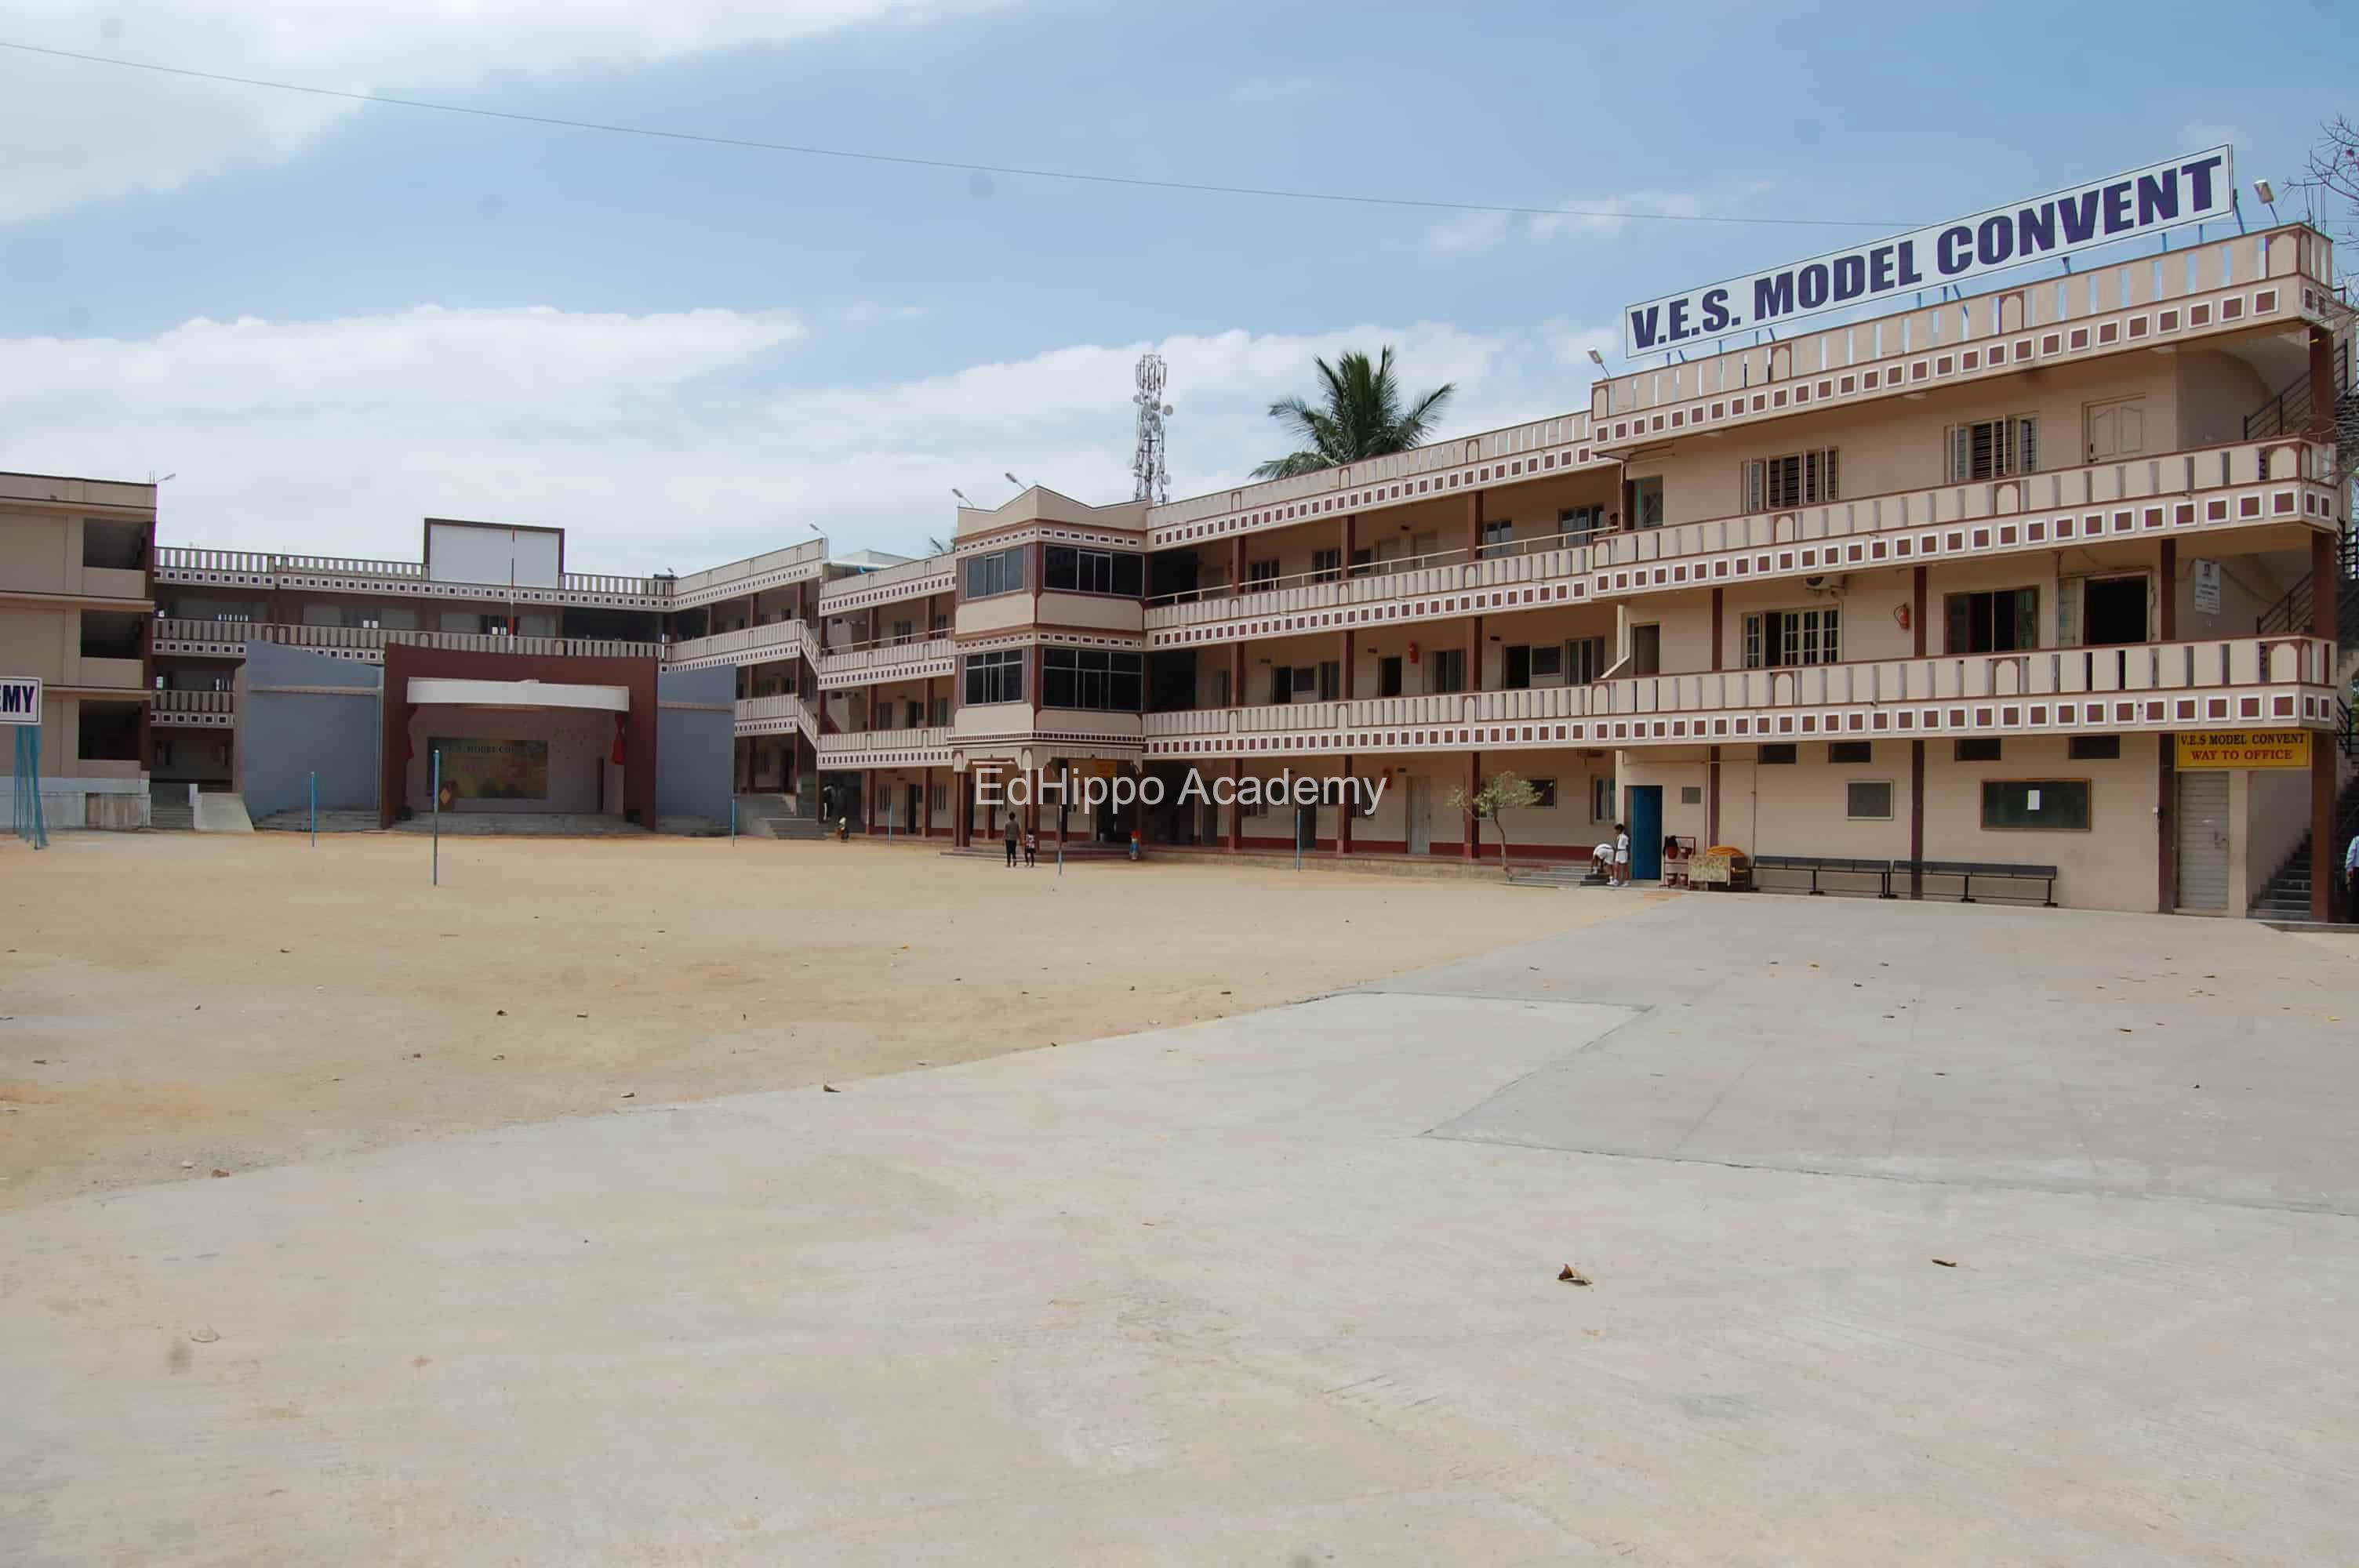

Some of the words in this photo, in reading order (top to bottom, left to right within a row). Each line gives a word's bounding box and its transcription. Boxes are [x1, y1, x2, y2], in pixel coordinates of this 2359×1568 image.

[1631, 289, 1741, 349] V.E.S.
[1754, 240, 1922, 321] MODEL
[1936, 155, 2222, 275] CONVENT
[0, 684, 35, 713] MY
[2181, 734, 2206, 746] V.E.S
[2209, 734, 2247, 746] MODEL
[2252, 733, 2305, 744] CONVENT
[2191, 750, 2217, 760] WAY
[2223, 750, 2239, 760] TO
[2244, 749, 2293, 760] OFFICE
